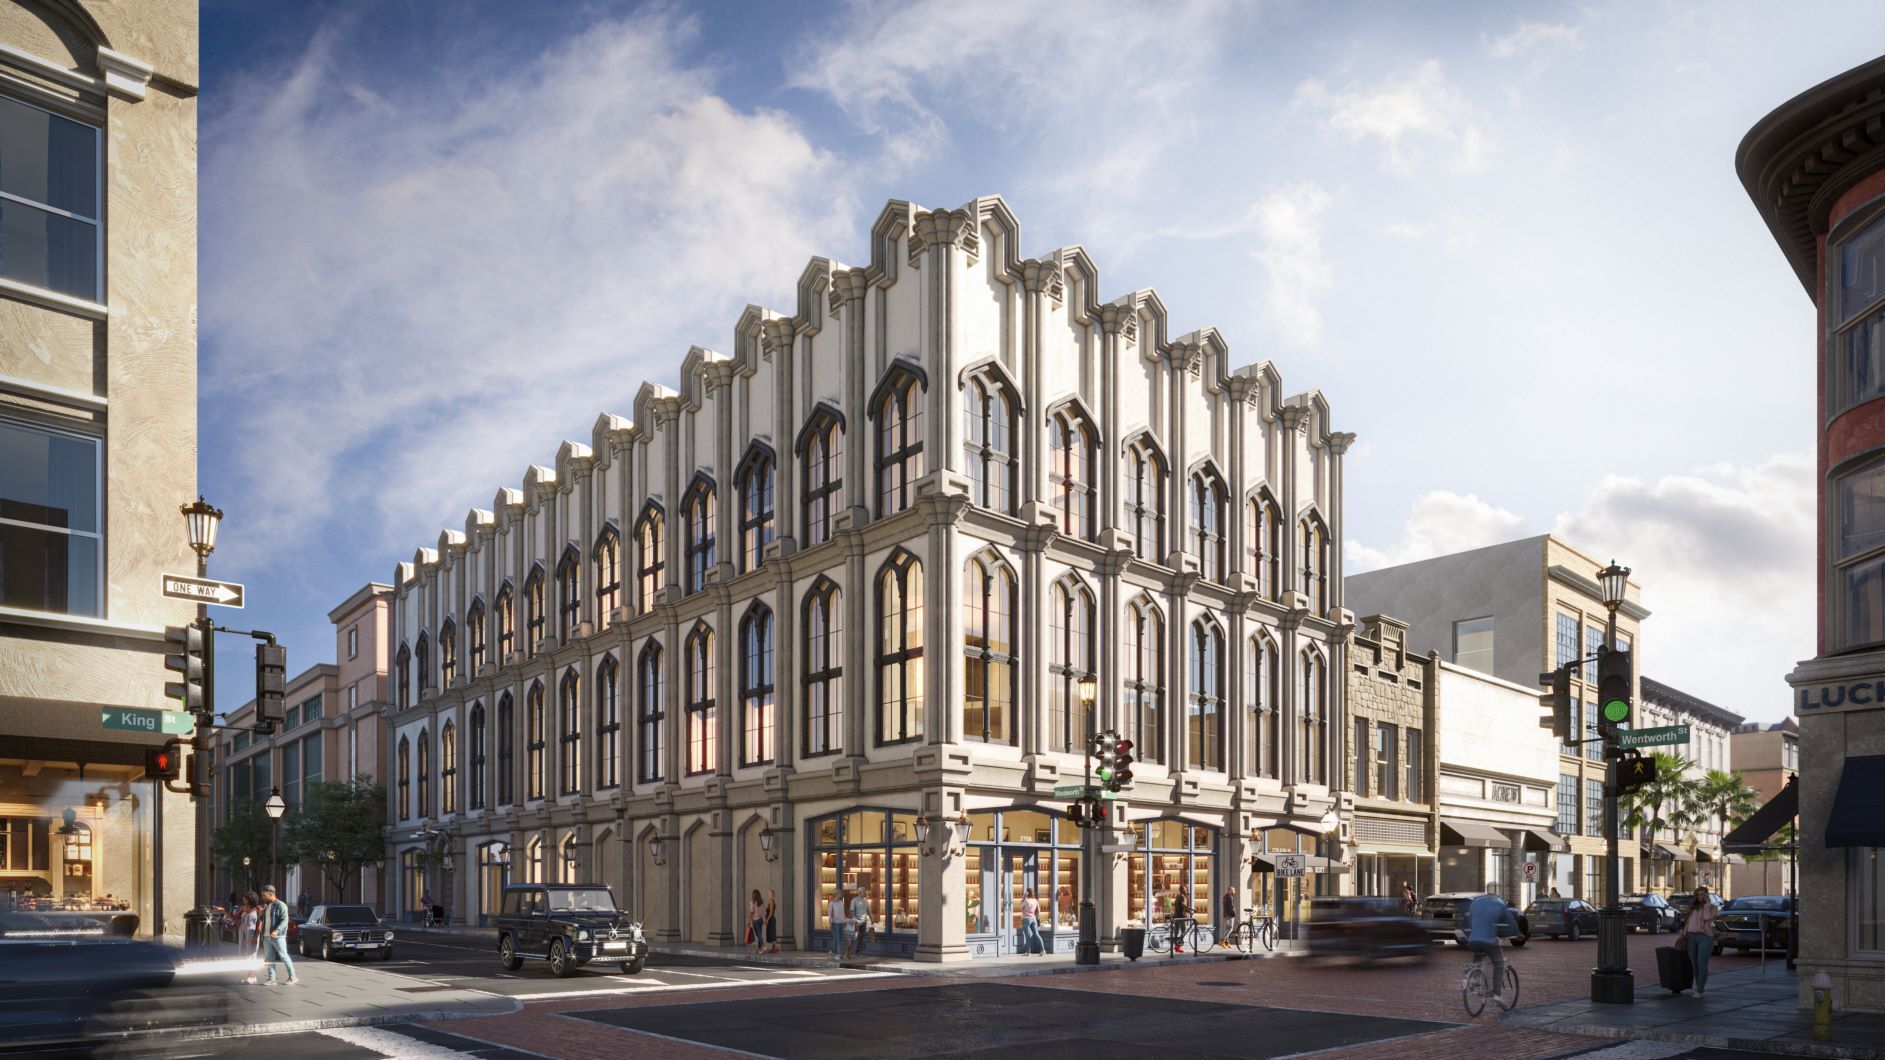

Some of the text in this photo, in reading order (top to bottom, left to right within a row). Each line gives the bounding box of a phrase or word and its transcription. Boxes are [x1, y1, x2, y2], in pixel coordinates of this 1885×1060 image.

[173, 582, 216, 597] ONE WAY
[121, 712, 176, 730] King St
[1621, 727, 1688, 745] Wentworth St
[1276, 868, 1289, 877] BIKE
[1290, 869, 1304, 877] LANE
